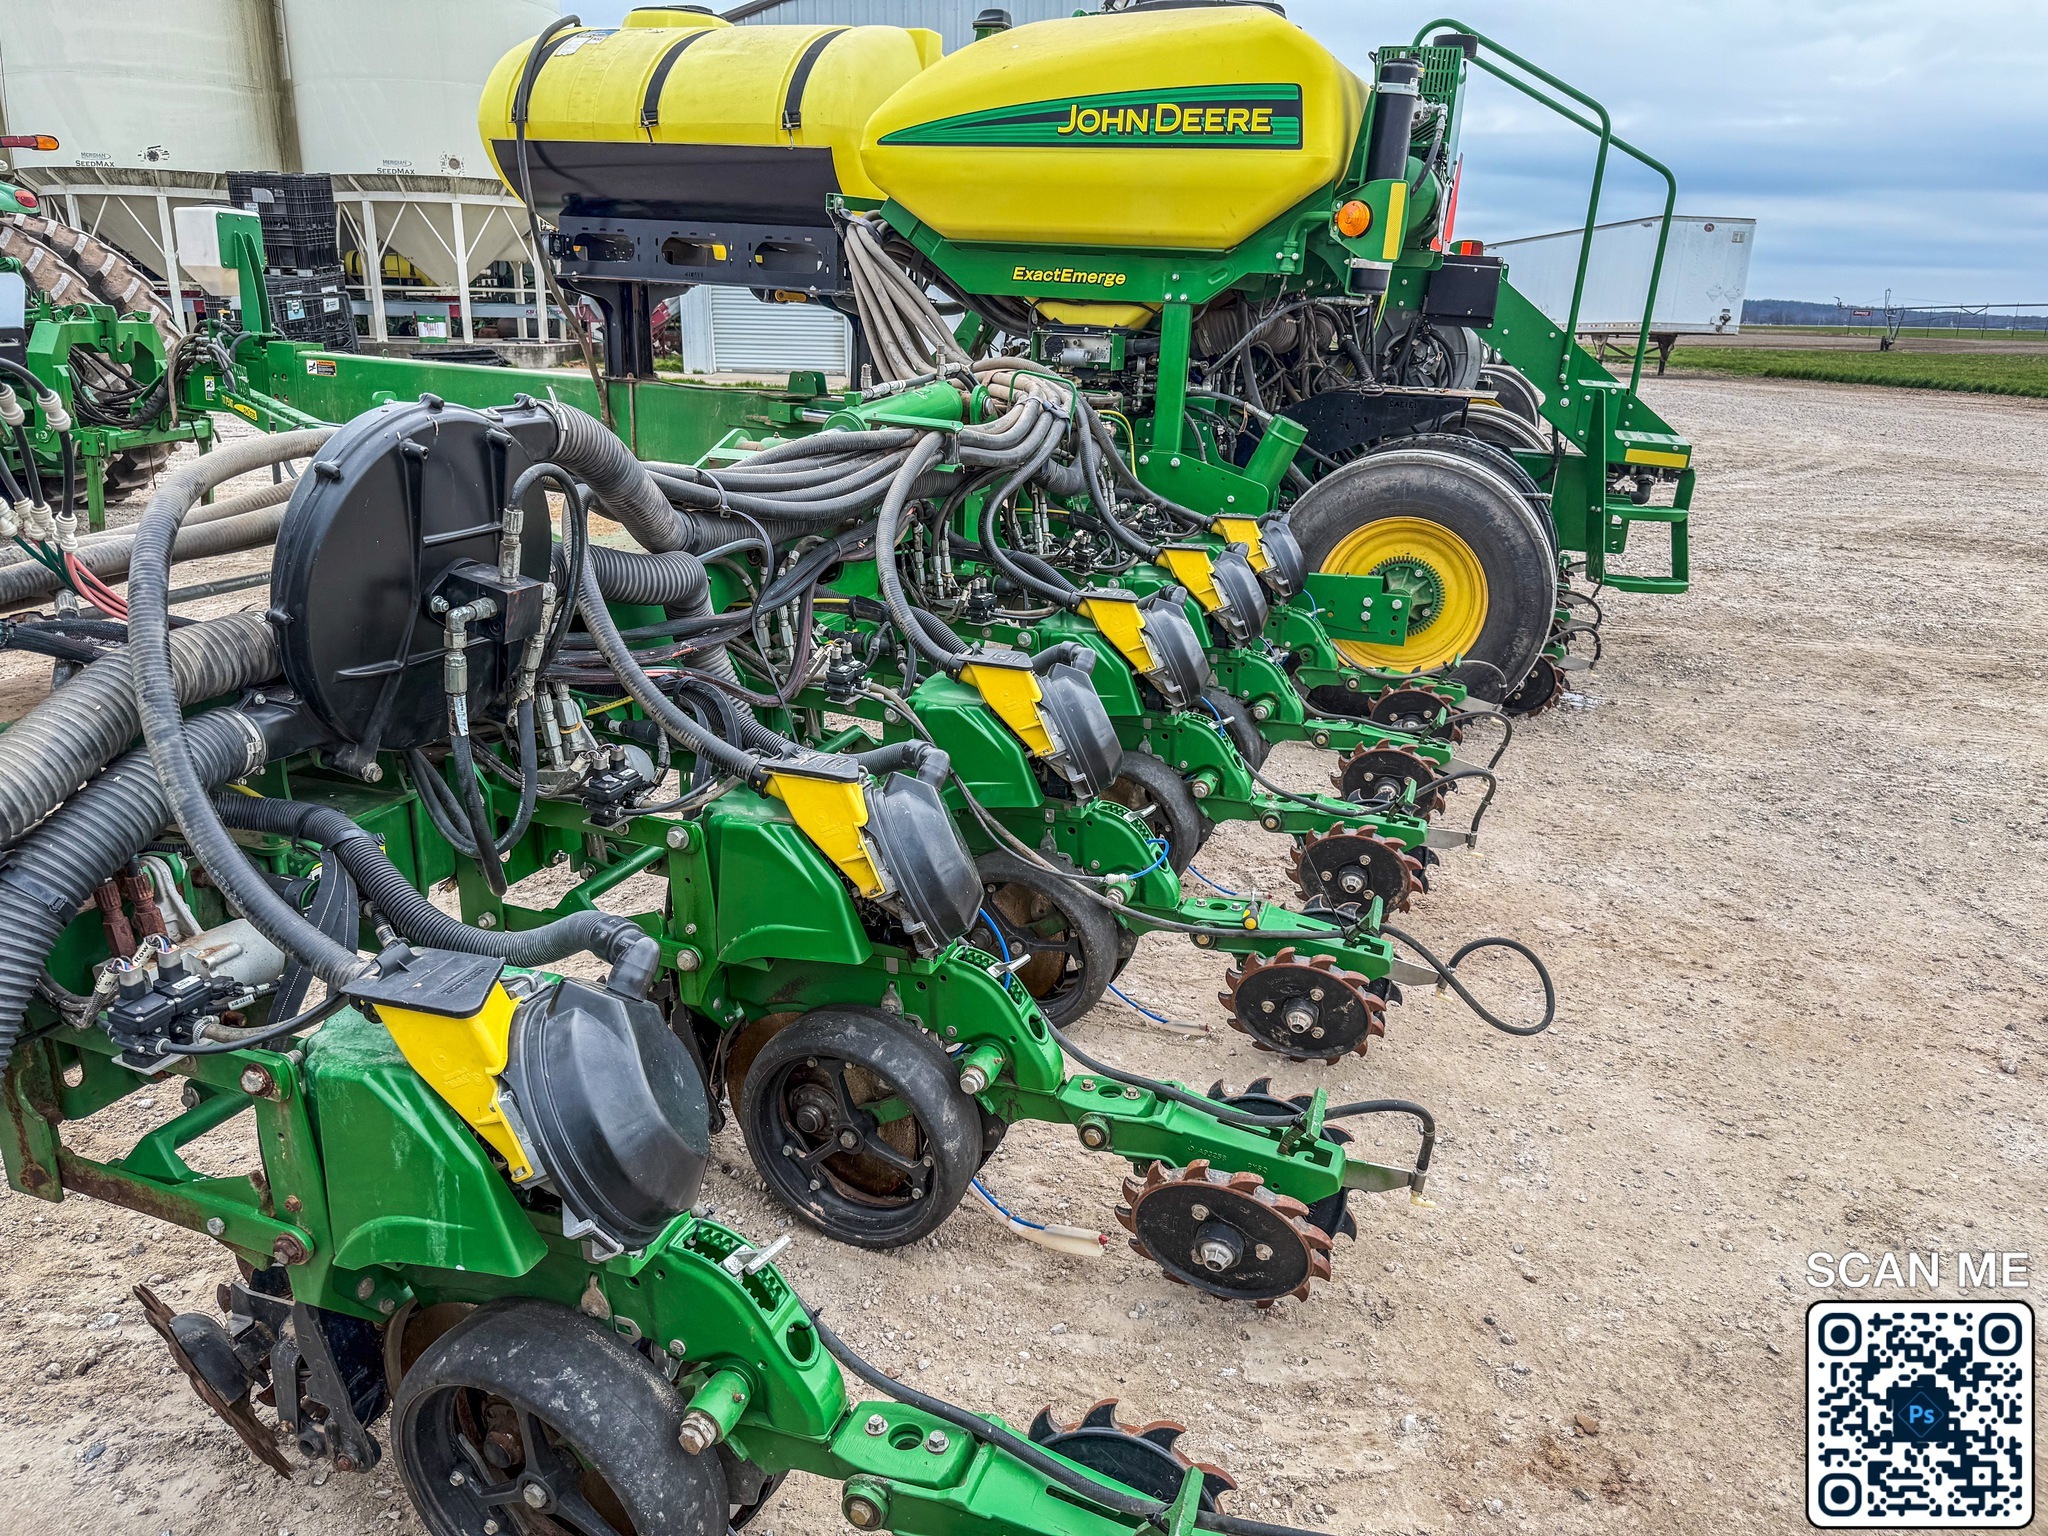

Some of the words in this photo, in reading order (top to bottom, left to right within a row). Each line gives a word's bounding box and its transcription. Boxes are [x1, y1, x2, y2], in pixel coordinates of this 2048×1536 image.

[1057, 103, 1150, 134] JOHN
[1154, 103, 1273, 134] DEERE
[1012, 266, 1126, 287] ExactEmerge
